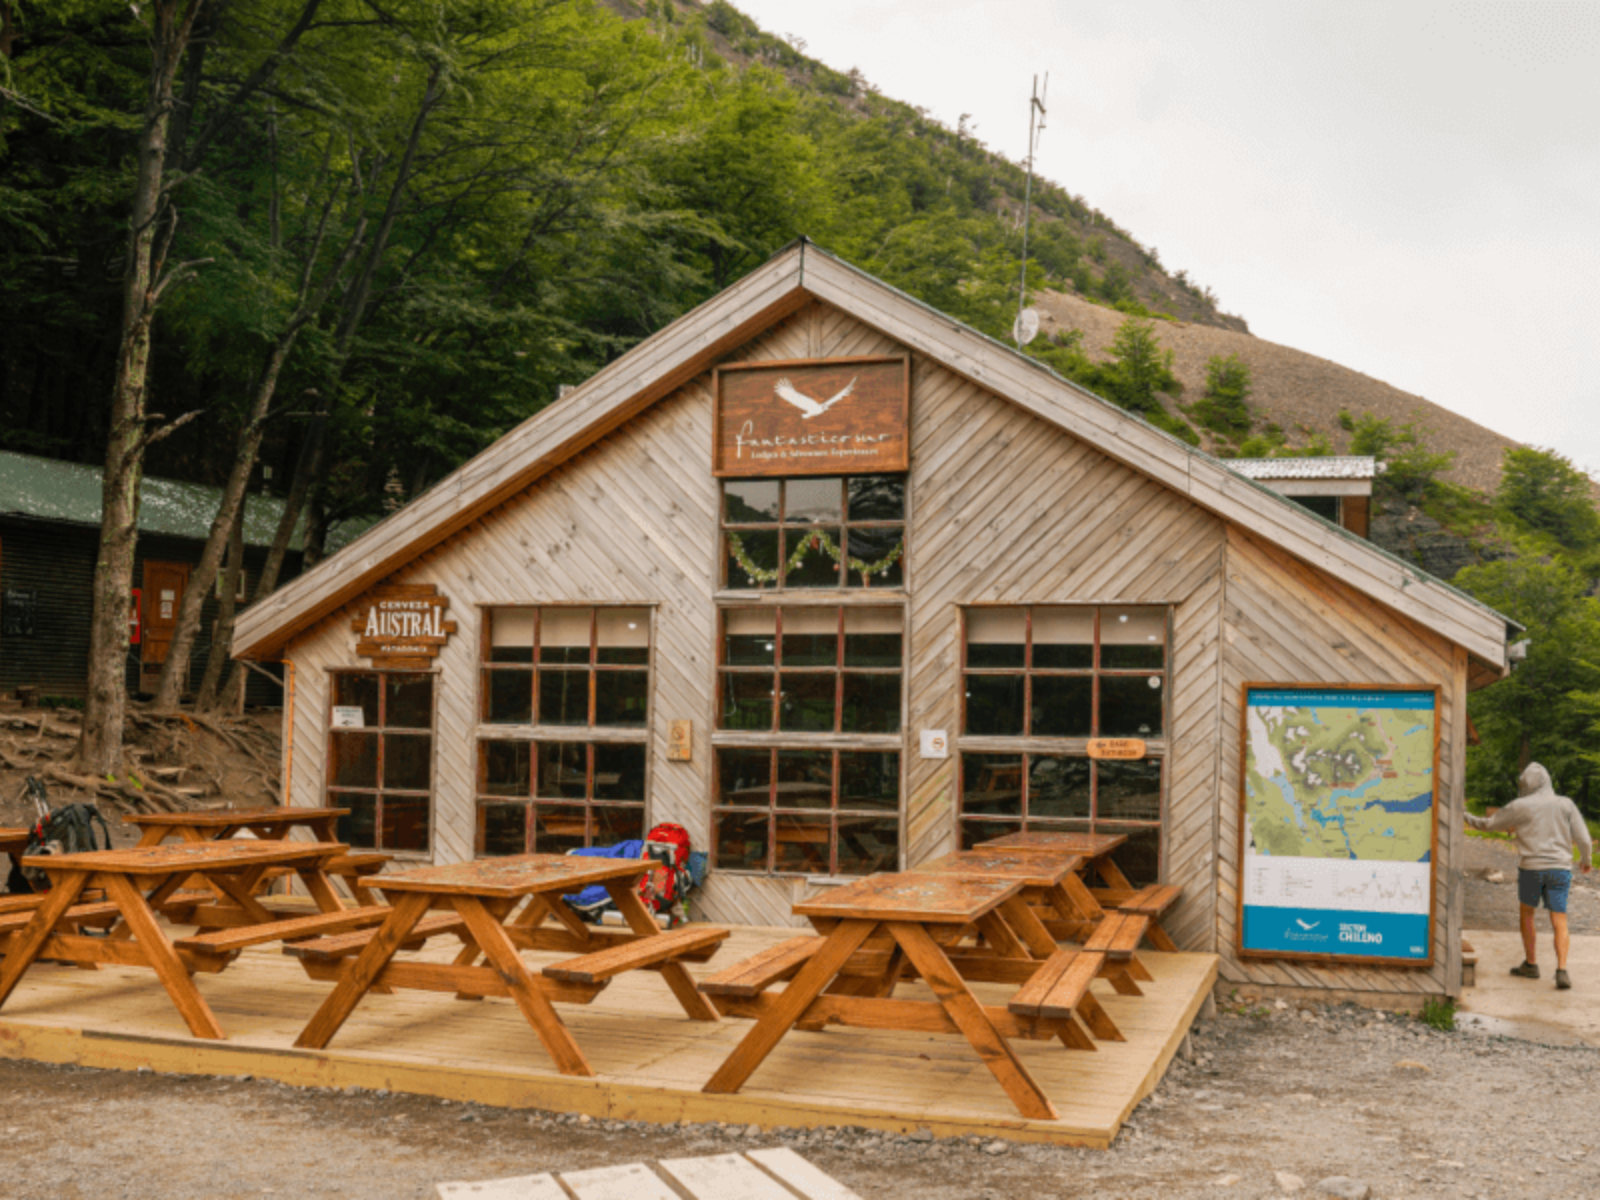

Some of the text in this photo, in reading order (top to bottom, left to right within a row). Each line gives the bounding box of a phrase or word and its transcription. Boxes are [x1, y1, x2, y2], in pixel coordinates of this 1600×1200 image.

[379, 600, 430, 609] CERVEZA
[364, 605, 446, 637] AUSTRAL
[1338, 931, 1383, 944] CHILENO
